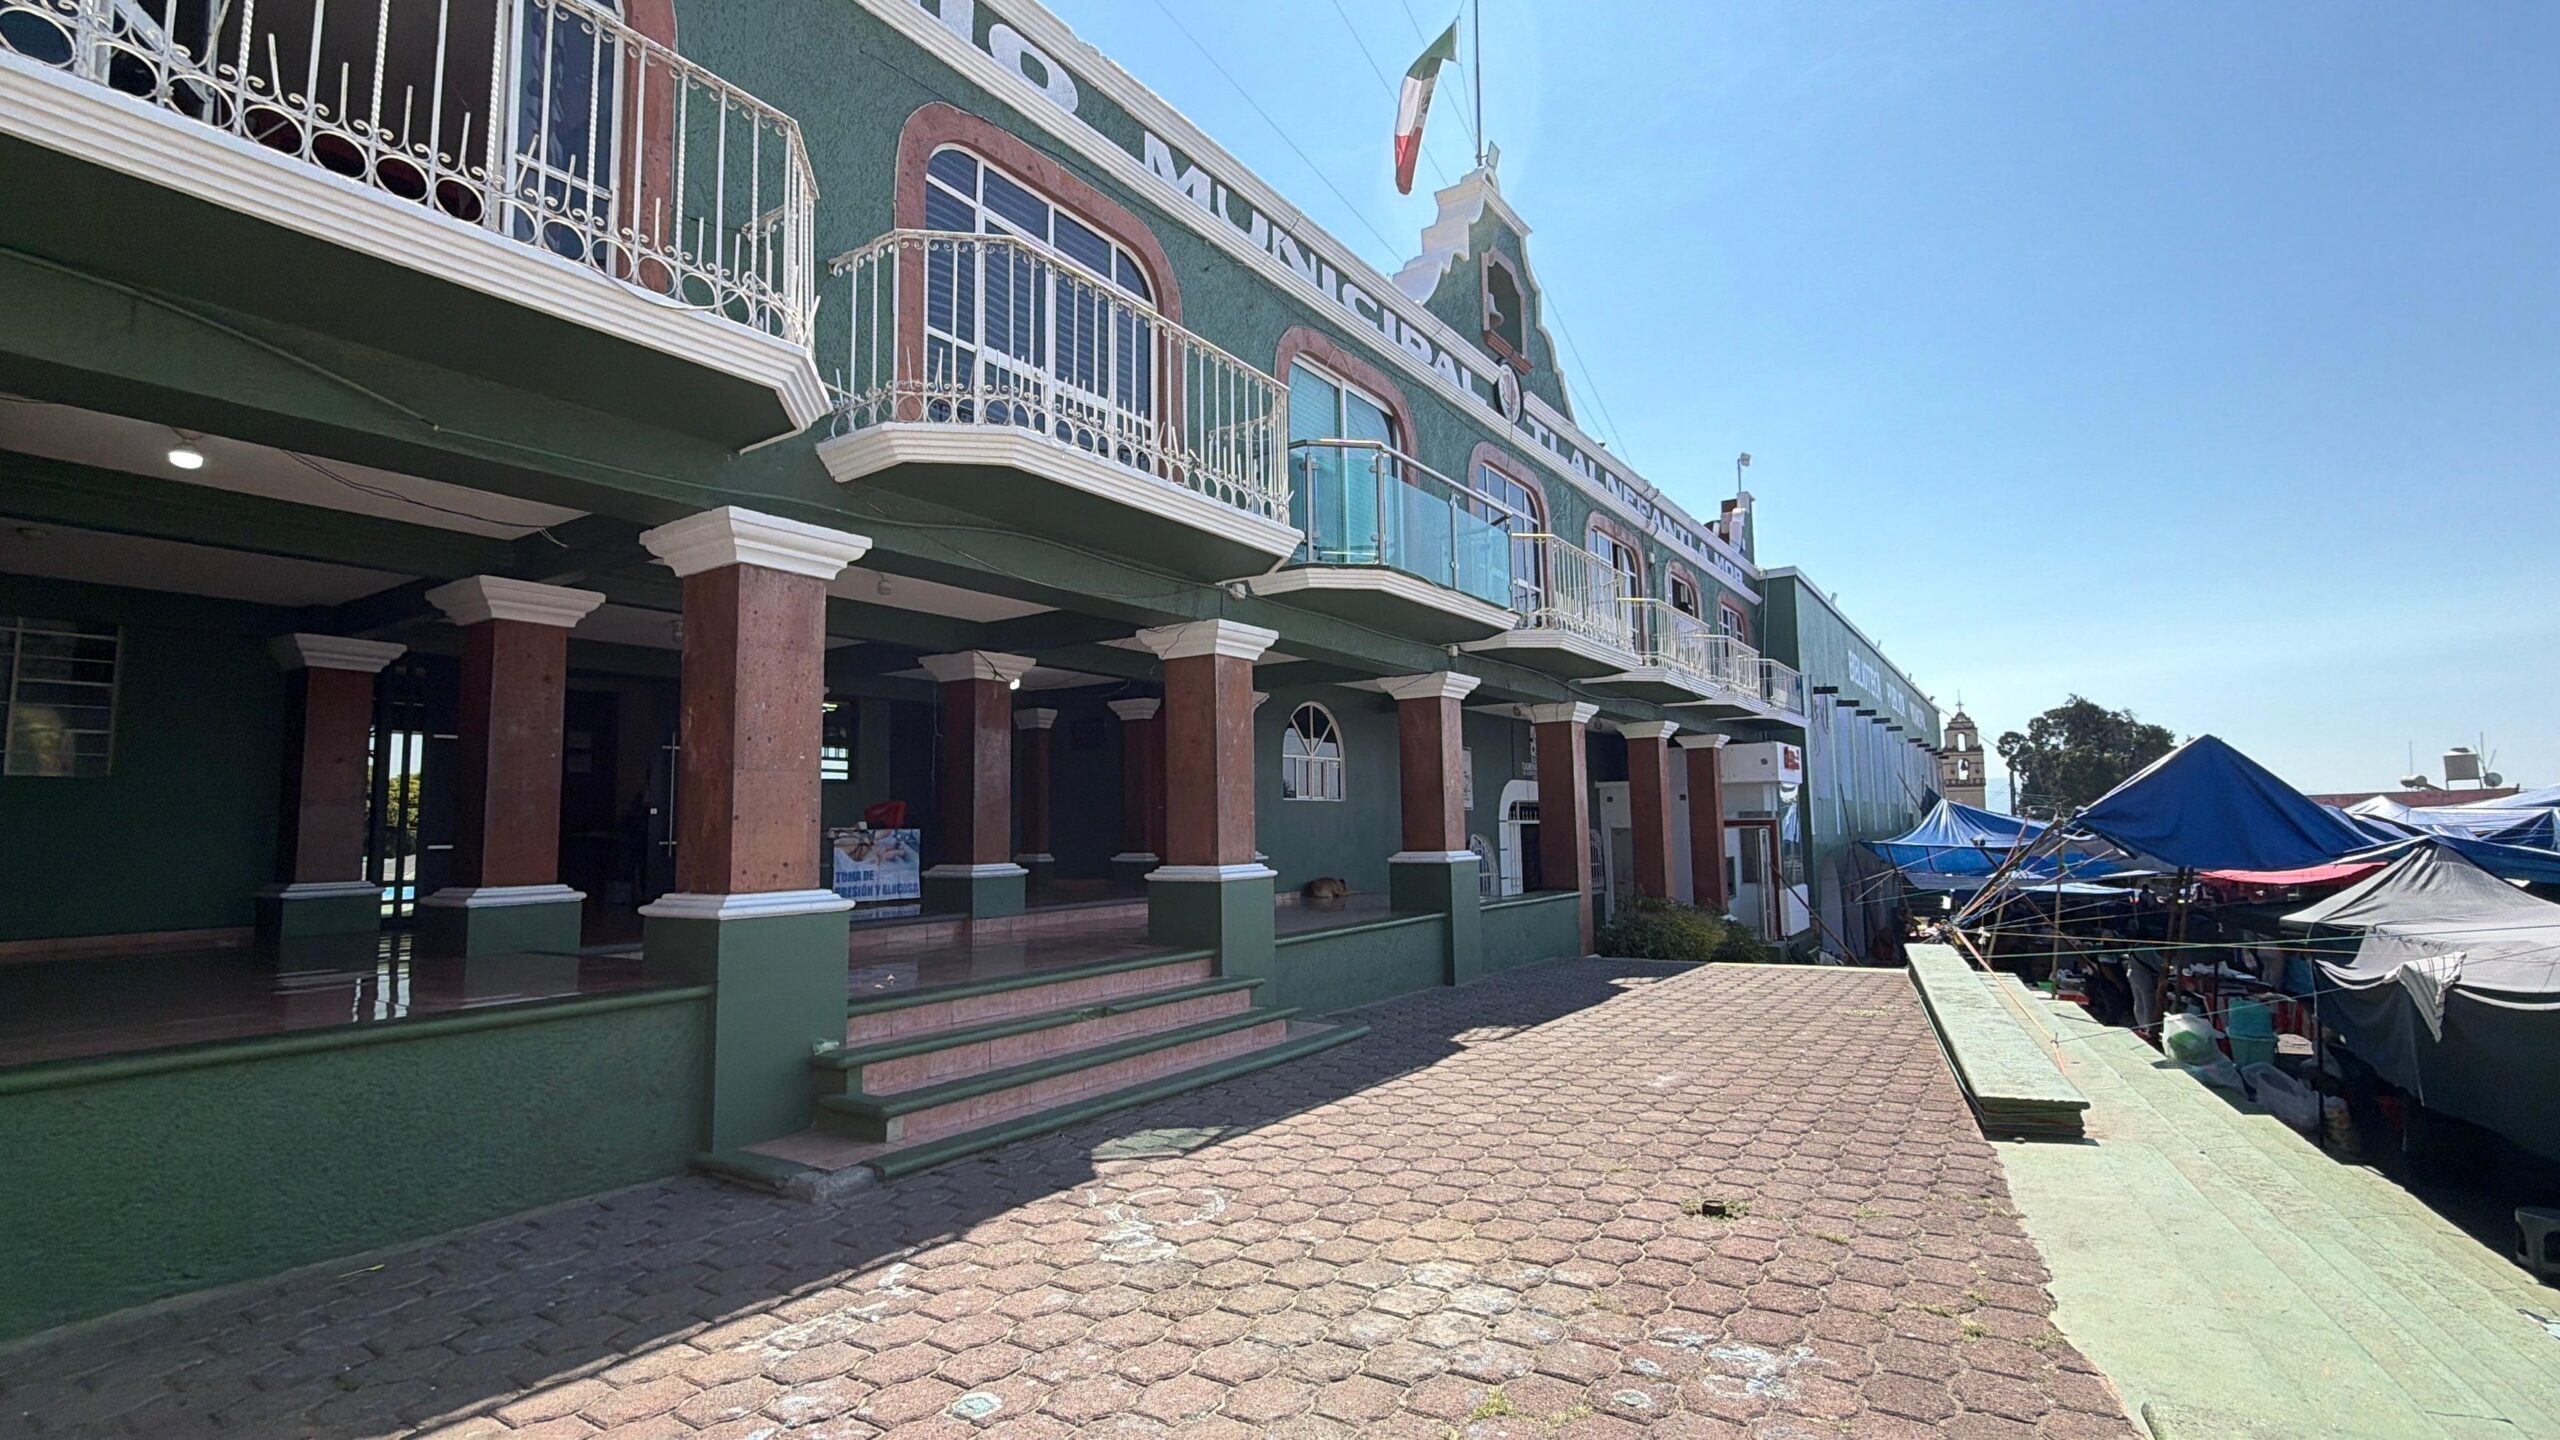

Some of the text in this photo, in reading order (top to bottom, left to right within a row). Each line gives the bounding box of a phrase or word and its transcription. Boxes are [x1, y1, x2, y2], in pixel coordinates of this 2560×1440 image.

[1144, 130, 1487, 404] MUNICIPAL
[835, 870, 874, 883] TOMA DE
[875, 884, 880, 896] Y
[882, 882, 919, 895] GLUCOSA
